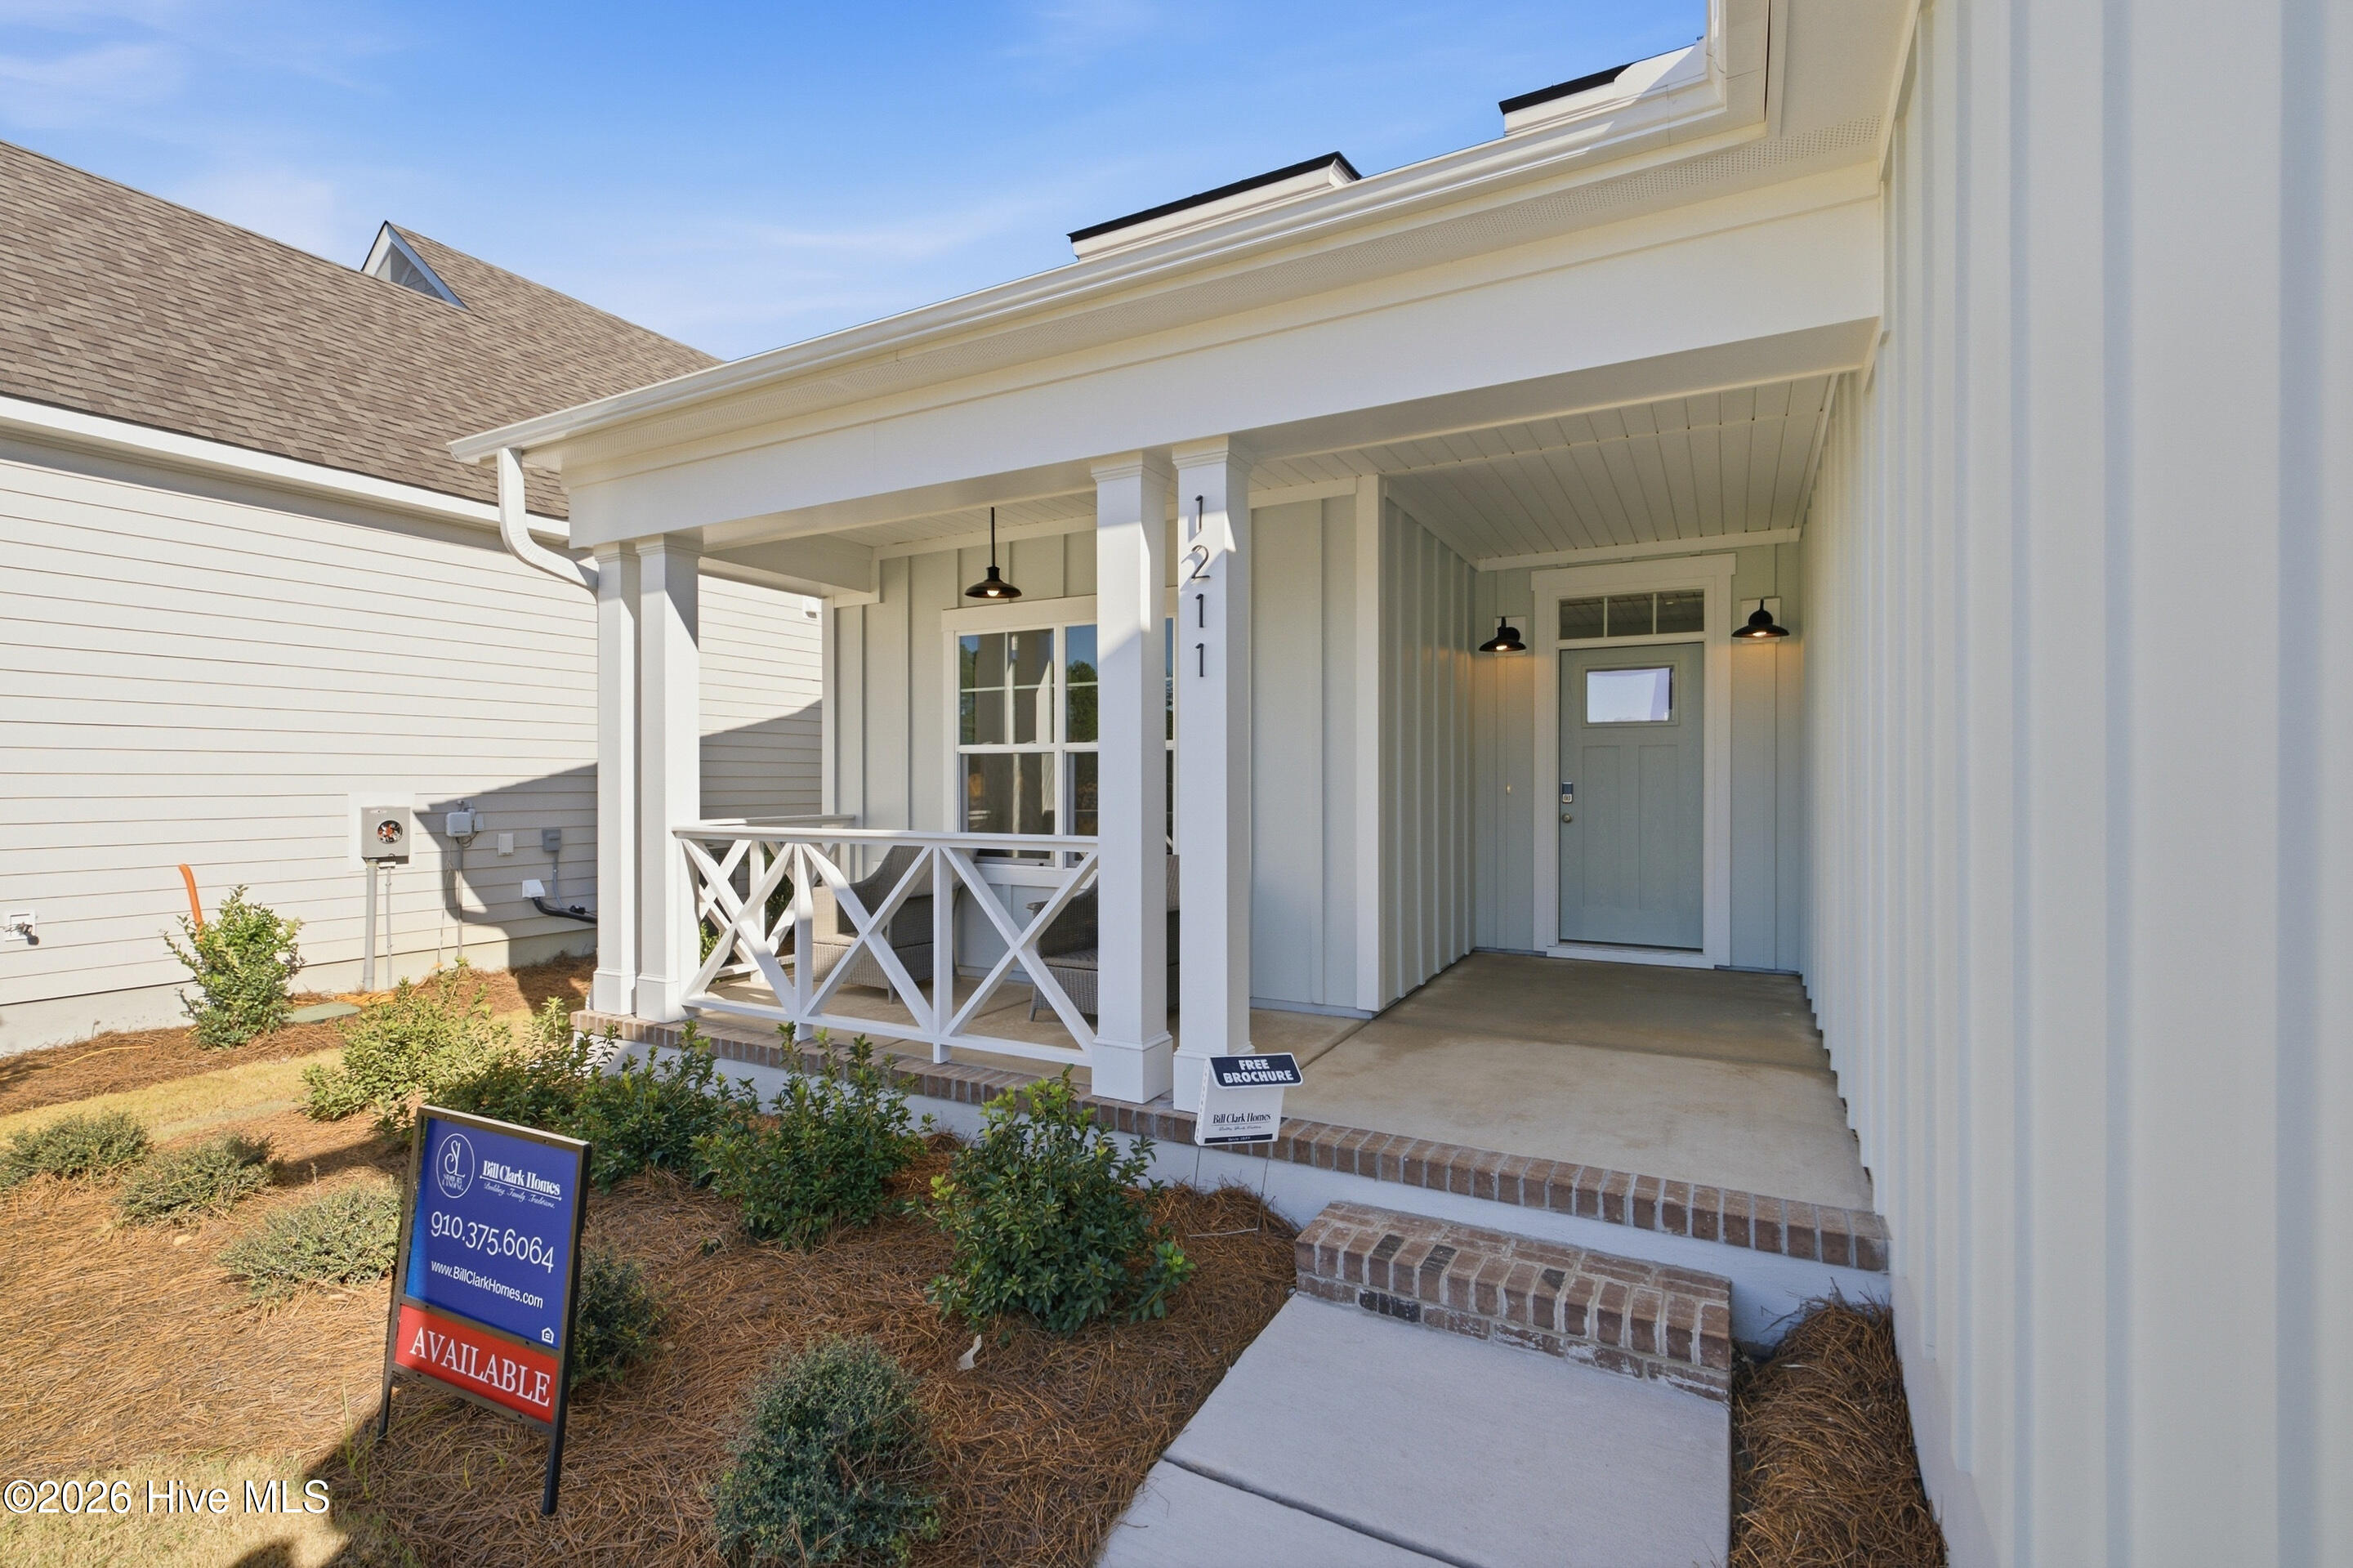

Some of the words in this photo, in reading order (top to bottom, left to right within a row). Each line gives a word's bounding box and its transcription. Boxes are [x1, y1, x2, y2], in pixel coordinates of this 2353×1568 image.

[1190, 495, 1210, 677] 1211
[1223, 1070, 1294, 1083] BROCHURE
[1239, 1059, 1270, 1070] FREE
[1212, 1114, 1226, 1124] Bill
[1226, 1113, 1246, 1123] Clark
[1247, 1112, 1271, 1122] Homes
[483, 1160, 498, 1180] Bill
[499, 1165, 525, 1186] Clark
[527, 1171, 560, 1195] Homes
[431, 1211, 554, 1273] 910.375.6064
[431, 1261, 543, 1309] www.BillClarkHomes.com
[409, 1327, 551, 1407] AVAILABLE
